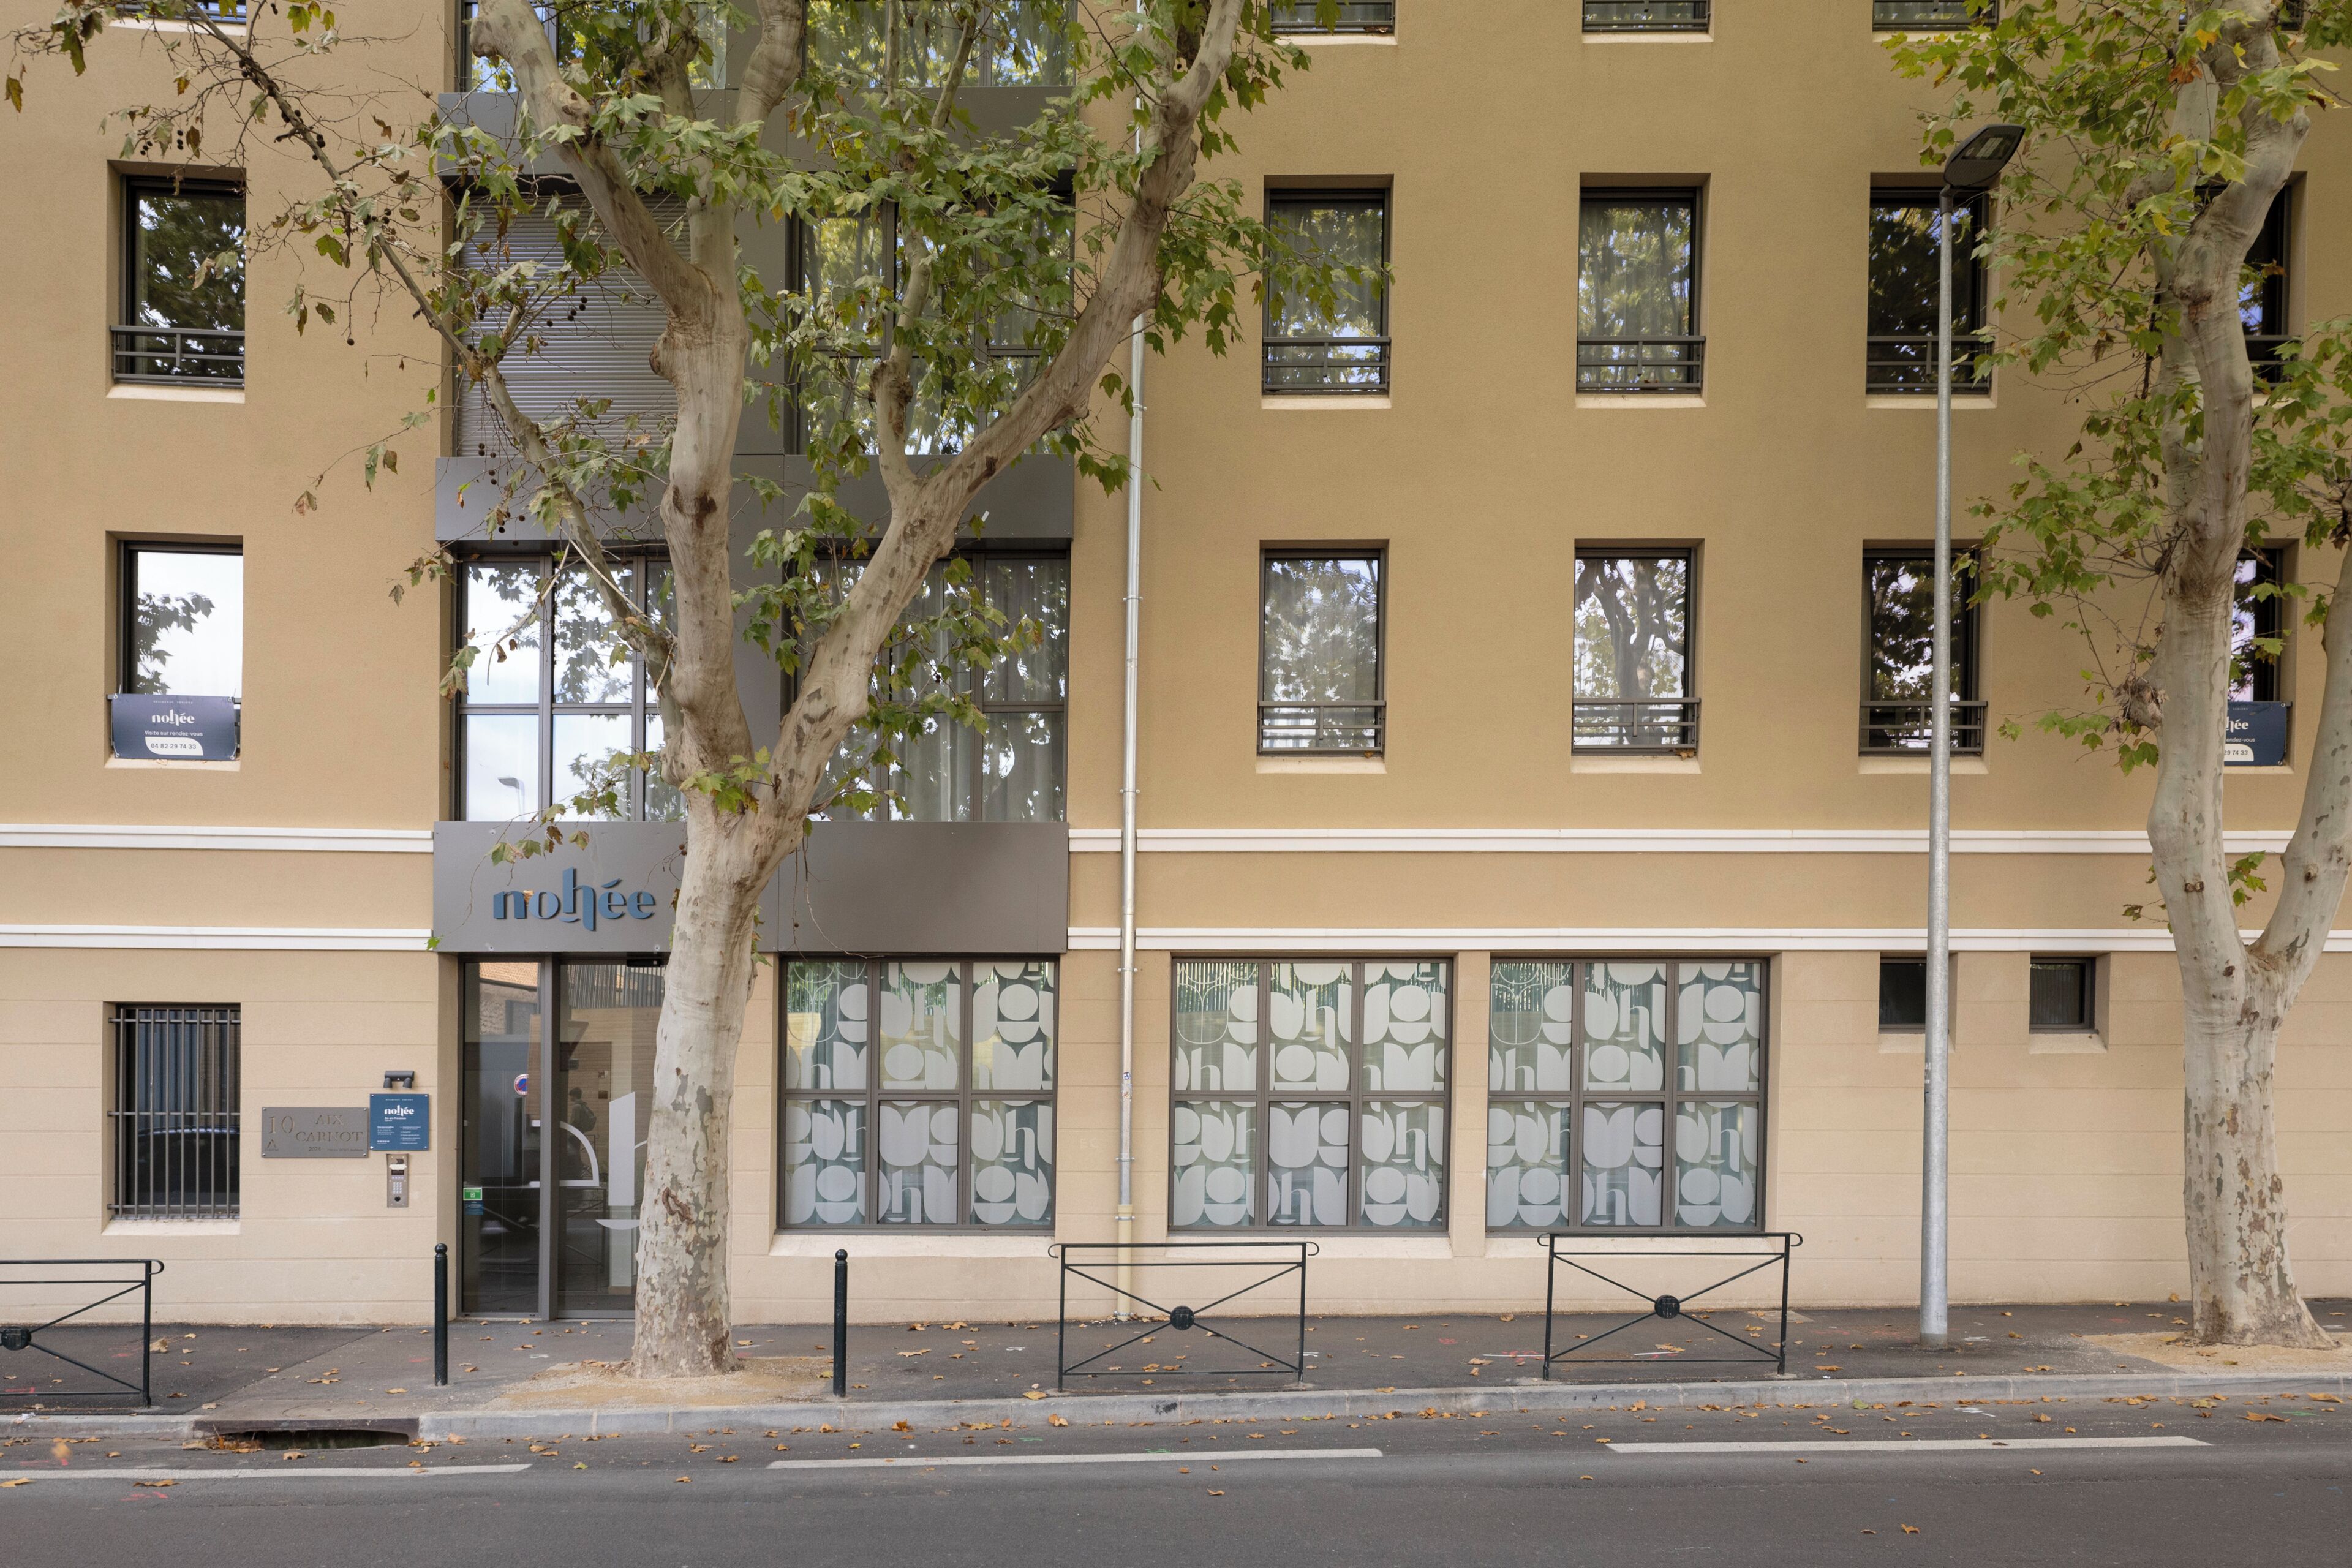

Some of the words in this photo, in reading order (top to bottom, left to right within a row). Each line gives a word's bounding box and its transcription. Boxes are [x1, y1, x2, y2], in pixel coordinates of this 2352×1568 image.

[151, 709, 195, 726] nohée
[2226, 716, 2249, 733] hée
[493, 866, 655, 932] nohée
[384, 1104, 415, 1117] nohée
[270, 1115, 294, 1134] 10
[315, 1115, 344, 1125] AIX
[295, 1132, 363, 1142] CARNOT
